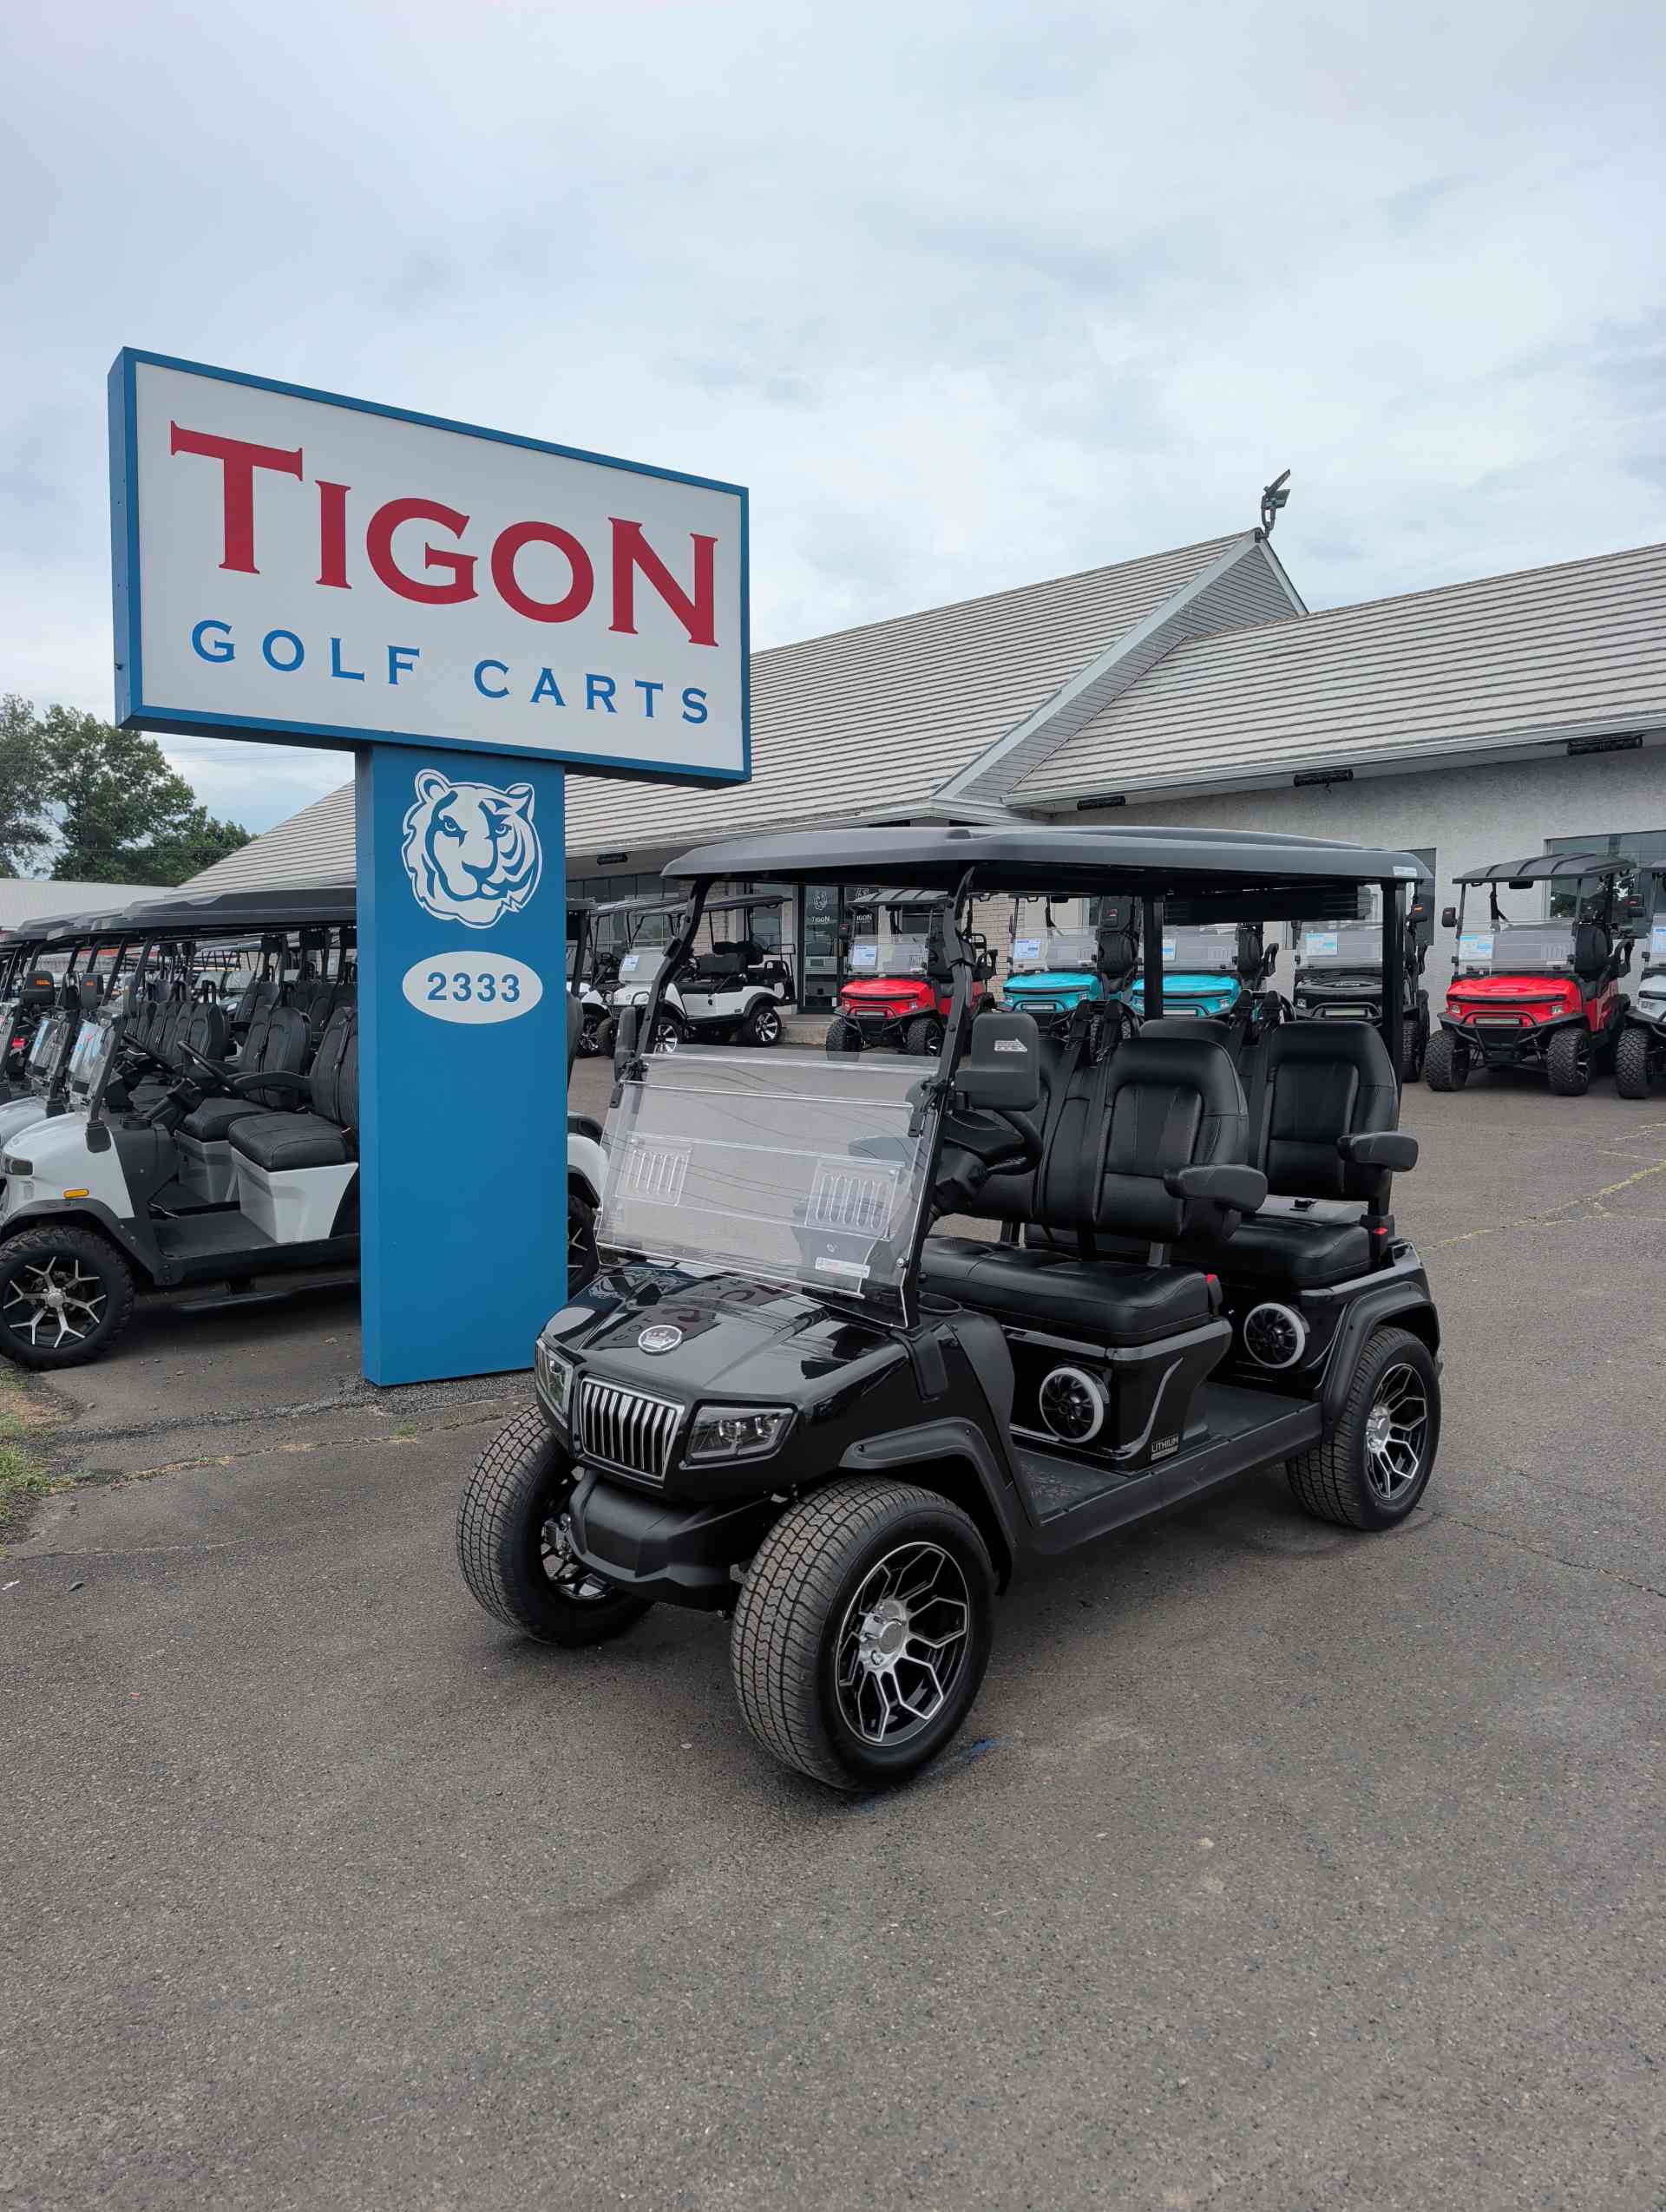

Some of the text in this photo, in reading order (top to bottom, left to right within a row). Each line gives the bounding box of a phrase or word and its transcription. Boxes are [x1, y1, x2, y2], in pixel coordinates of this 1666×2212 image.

[170, 420, 718, 647] TIGON
[191, 619, 710, 724] GOLF CARTS
[427, 972, 521, 1004] 2333
[1151, 1436, 1179, 1452] LITHIUM
